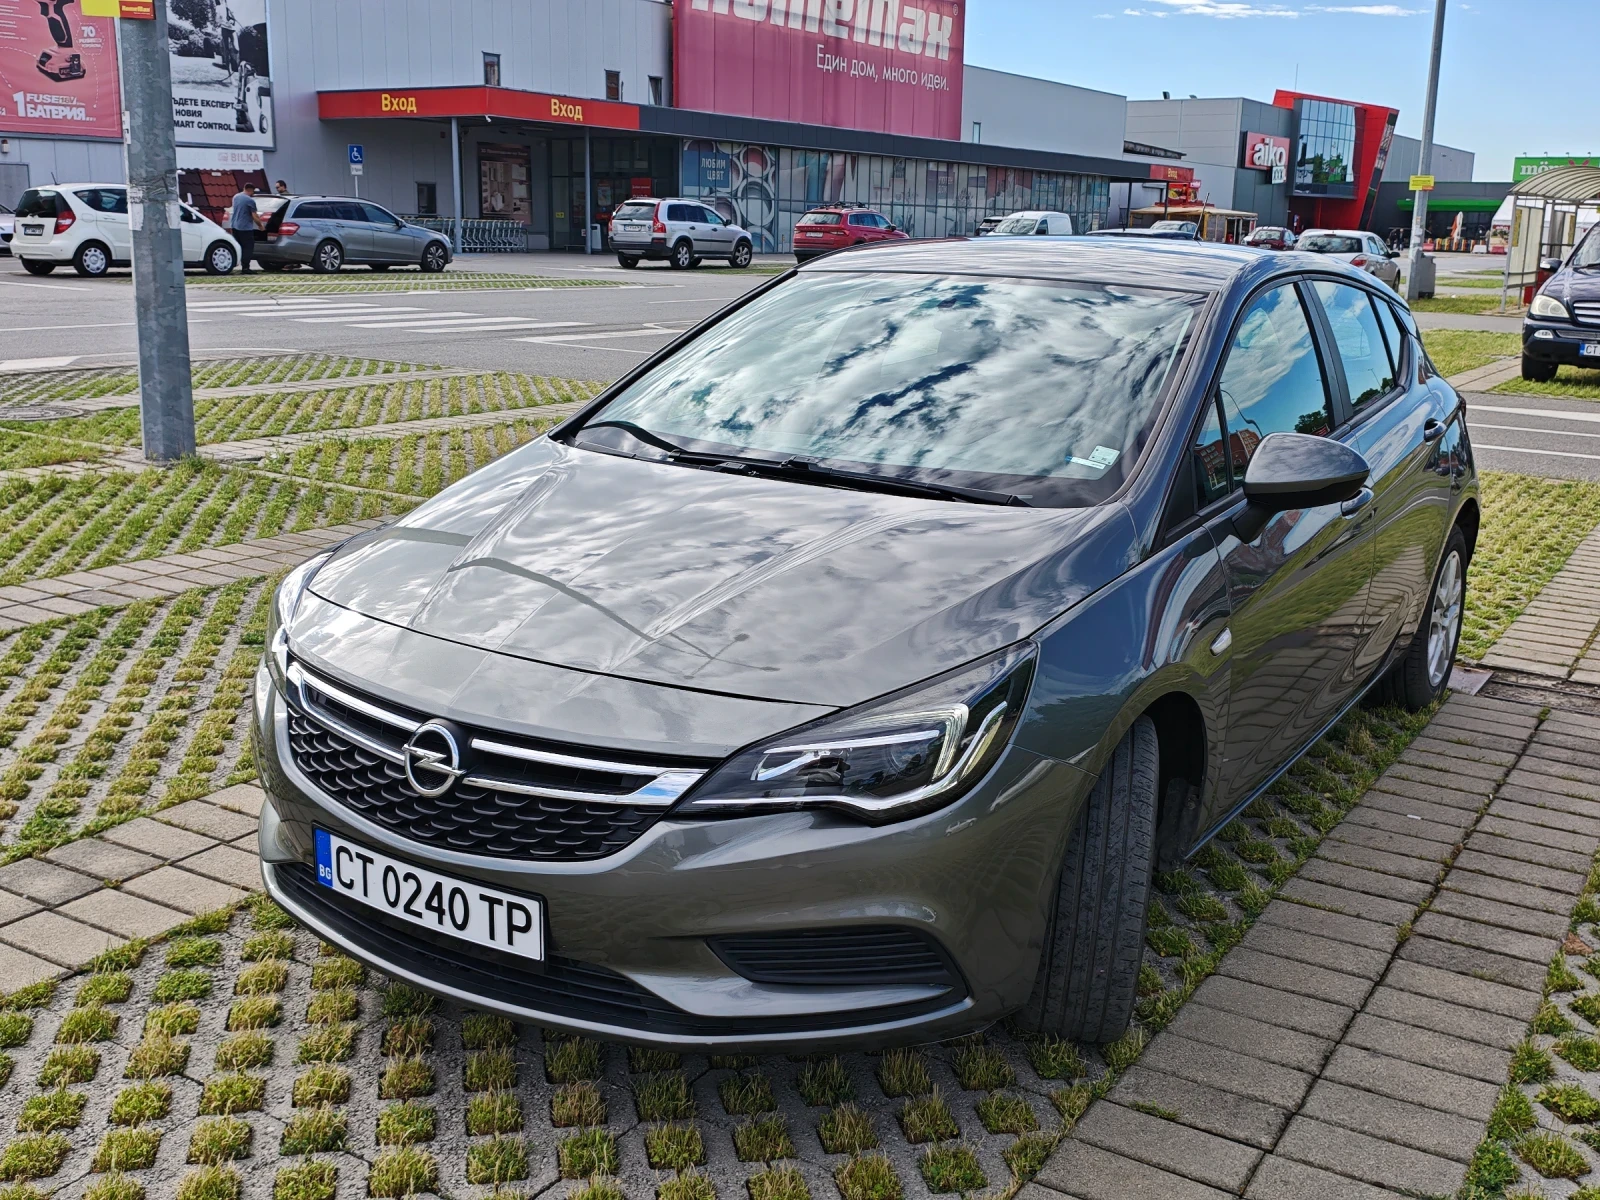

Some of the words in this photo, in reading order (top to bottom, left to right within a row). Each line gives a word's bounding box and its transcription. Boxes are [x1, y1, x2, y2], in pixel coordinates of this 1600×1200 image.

[81, 26, 96, 38] 70
[816, 43, 848, 74] Един
[850, 59, 878, 83] дом,
[882, 65, 918, 85] много
[920, 71, 950, 91] идеи.
[12, 90, 26, 117] 1
[173, 97, 199, 107] ЪДЕТЕ
[381, 93, 417, 114] Вход
[551, 98, 583, 122] Вход
[26, 103, 96, 122] БАТЕРИЯ...
[175, 109, 203, 118] НОВИЯ
[174, 119, 195, 129] MART
[230, 152, 260, 163] BILKA
[1252, 137, 1286, 167] aiko
[701, 158, 726, 169] ЛЮБИМ
[319, 863, 332, 880] BG
[335, 845, 374, 898] CT
[382, 864, 470, 931] 0240
[479, 893, 532, 946] TP
